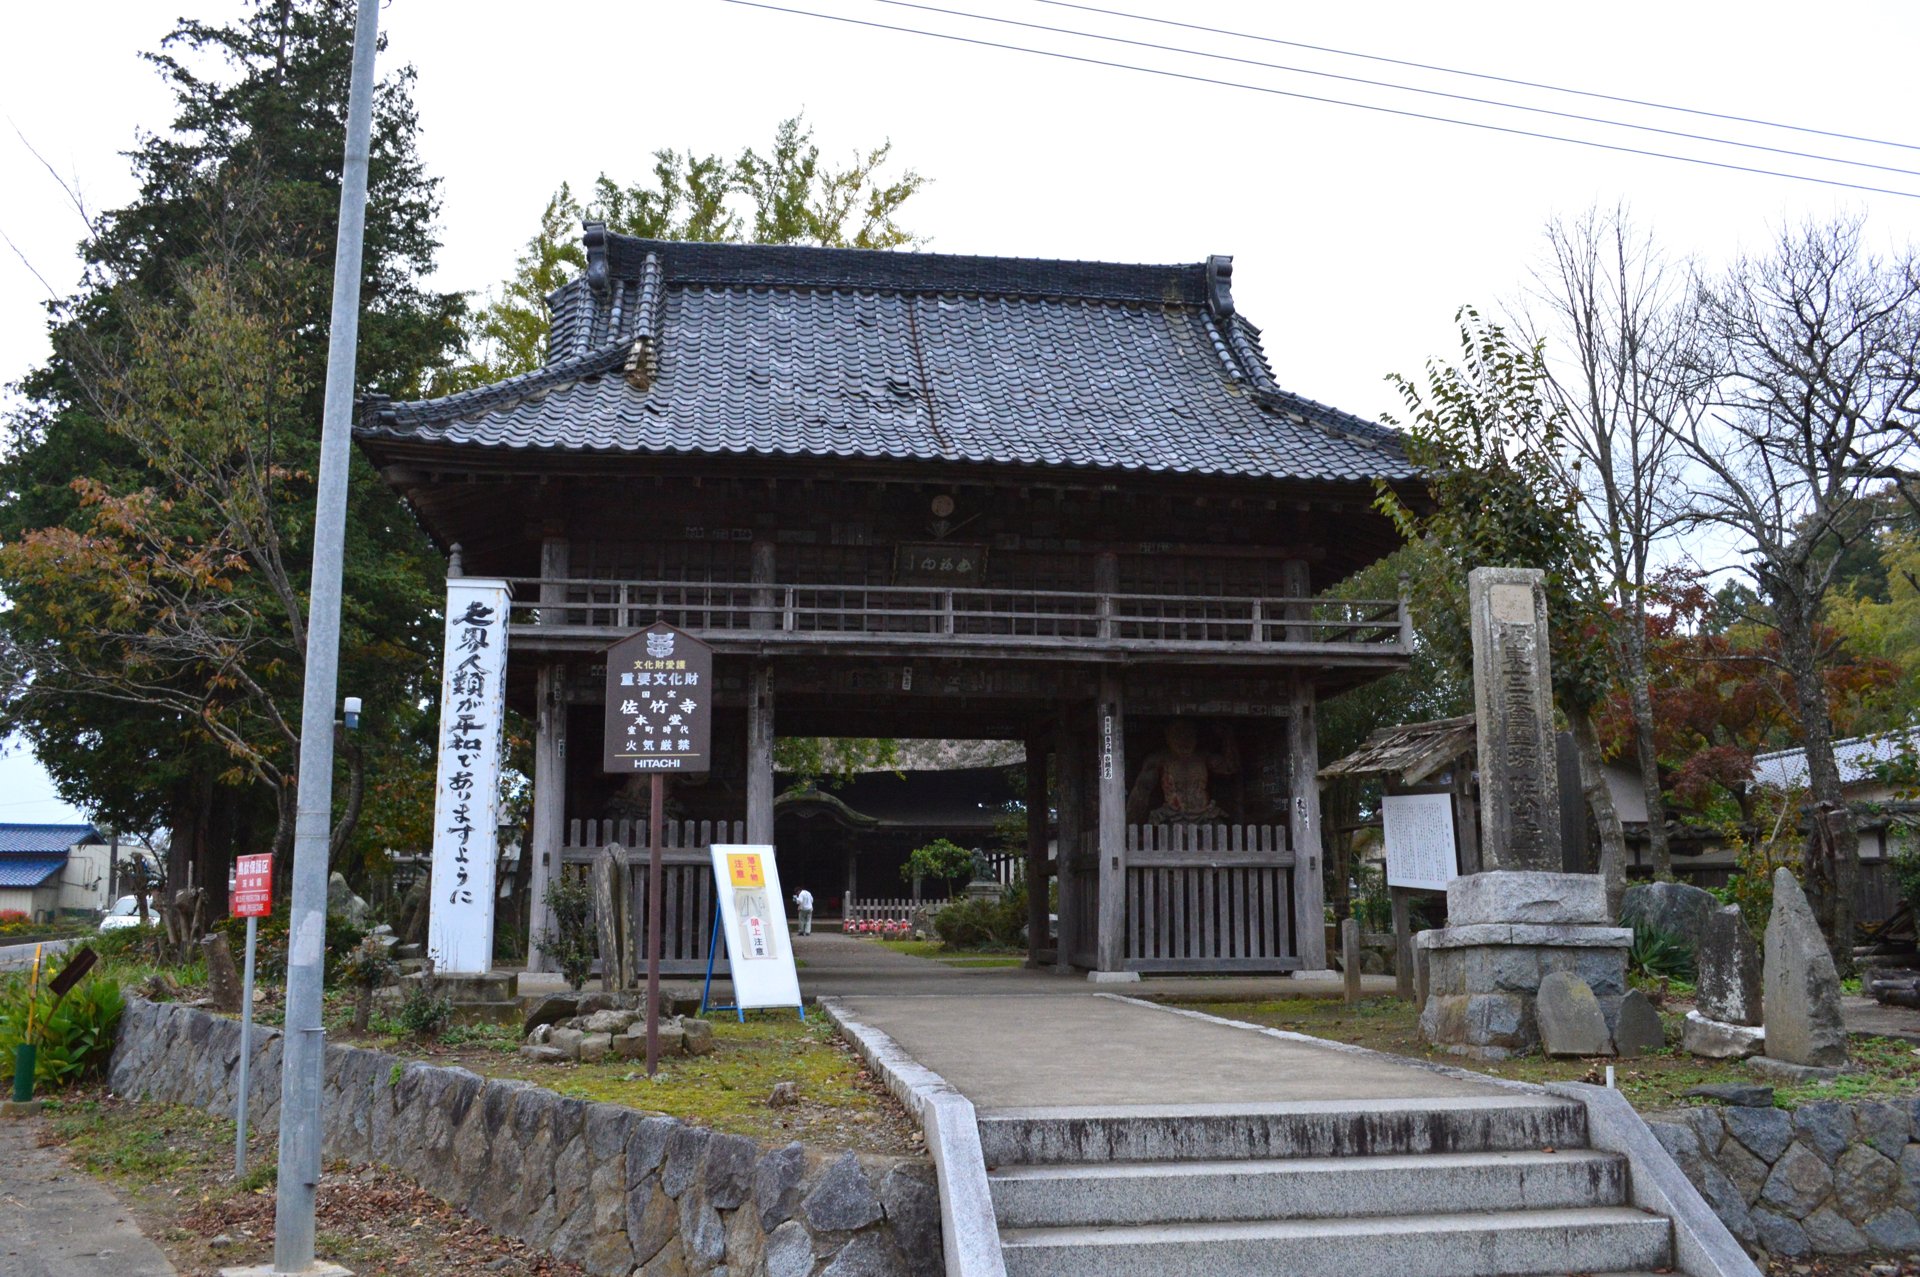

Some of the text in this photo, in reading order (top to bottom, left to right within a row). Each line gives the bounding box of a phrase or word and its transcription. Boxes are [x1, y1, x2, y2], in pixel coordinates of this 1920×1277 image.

[634, 660, 686, 669] 文化財愛護
[620, 672, 698, 686] 重要文化財
[620, 698, 697, 714] 佐竹寺
[634, 714, 683, 725] 本堂
[627, 726, 689, 735] 室町時代
[626, 739, 690, 751] 火気厳禁
[447, 601, 495, 904] 世界人類が平和でありますように
[634, 759, 681, 768] HITACHI
[734, 859, 745, 879] 注意
[750, 918, 764, 956] 頭上注意
